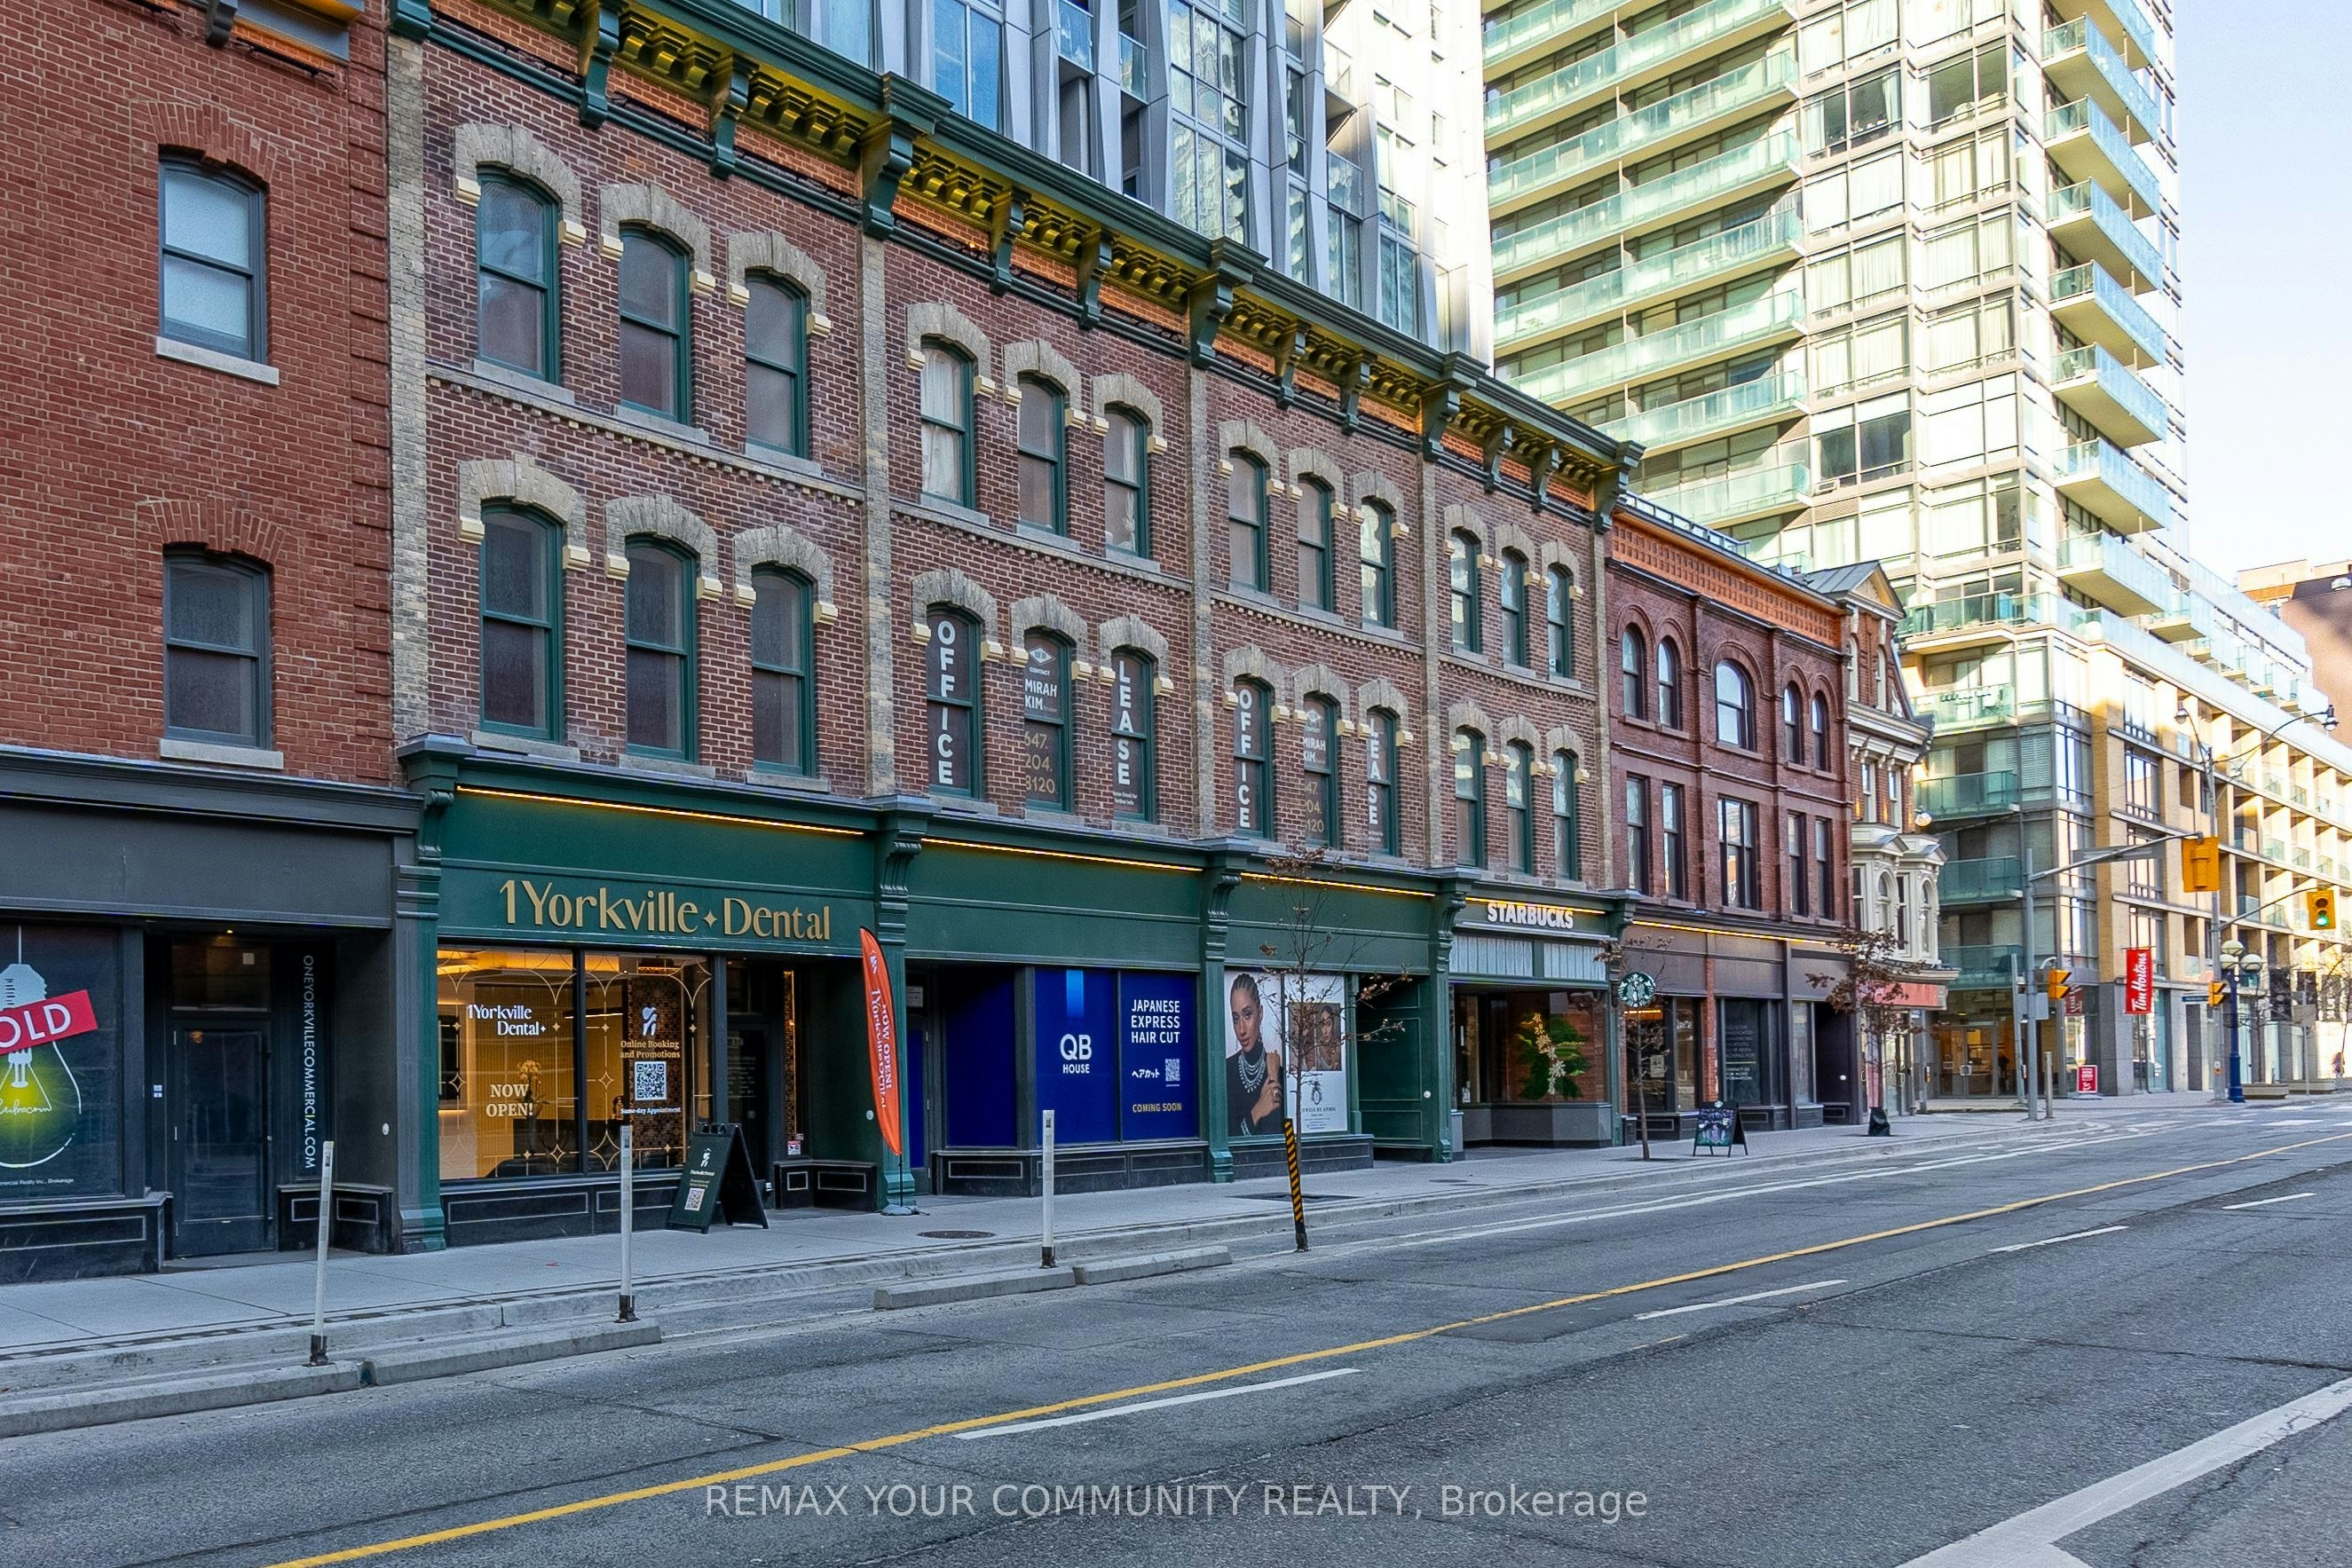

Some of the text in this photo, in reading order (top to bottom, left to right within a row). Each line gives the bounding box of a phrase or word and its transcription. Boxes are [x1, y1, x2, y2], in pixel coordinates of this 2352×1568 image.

[1024, 678, 1057, 698] MIRAH
[937, 620, 956, 785] OFFICE
[1024, 695, 1044, 710] KIM
[1117, 659, 1134, 785] LEASE
[1238, 689, 1252, 829] OFFICE
[1368, 717, 1382, 825] LEASE
[723, 897, 831, 941] Dental
[1488, 902, 1575, 929] STARBUCKS
[2131, 952, 2147, 1012] Tim Hortons
[1132, 999, 1180, 1013] JAPANESE
[497, 1020, 540, 1036] Dental
[1131, 1015, 1180, 1028] EXPRESS
[648, 1040, 679, 1050] Booking
[1131, 1031, 1180, 1044] HAIR CUT
[620, 1049, 681, 1059] and Promotions
[1060, 1033, 1093, 1060] QB
[303, 955, 316, 1170] ONEYORKVILLECOMMERCIAL.COM
[1062, 1064, 1090, 1074] HOUSE
[490, 1083, 530, 1098] NOW
[485, 1102, 533, 1117] OPEN!
[1132, 1102, 1182, 1113] COMING SOON
